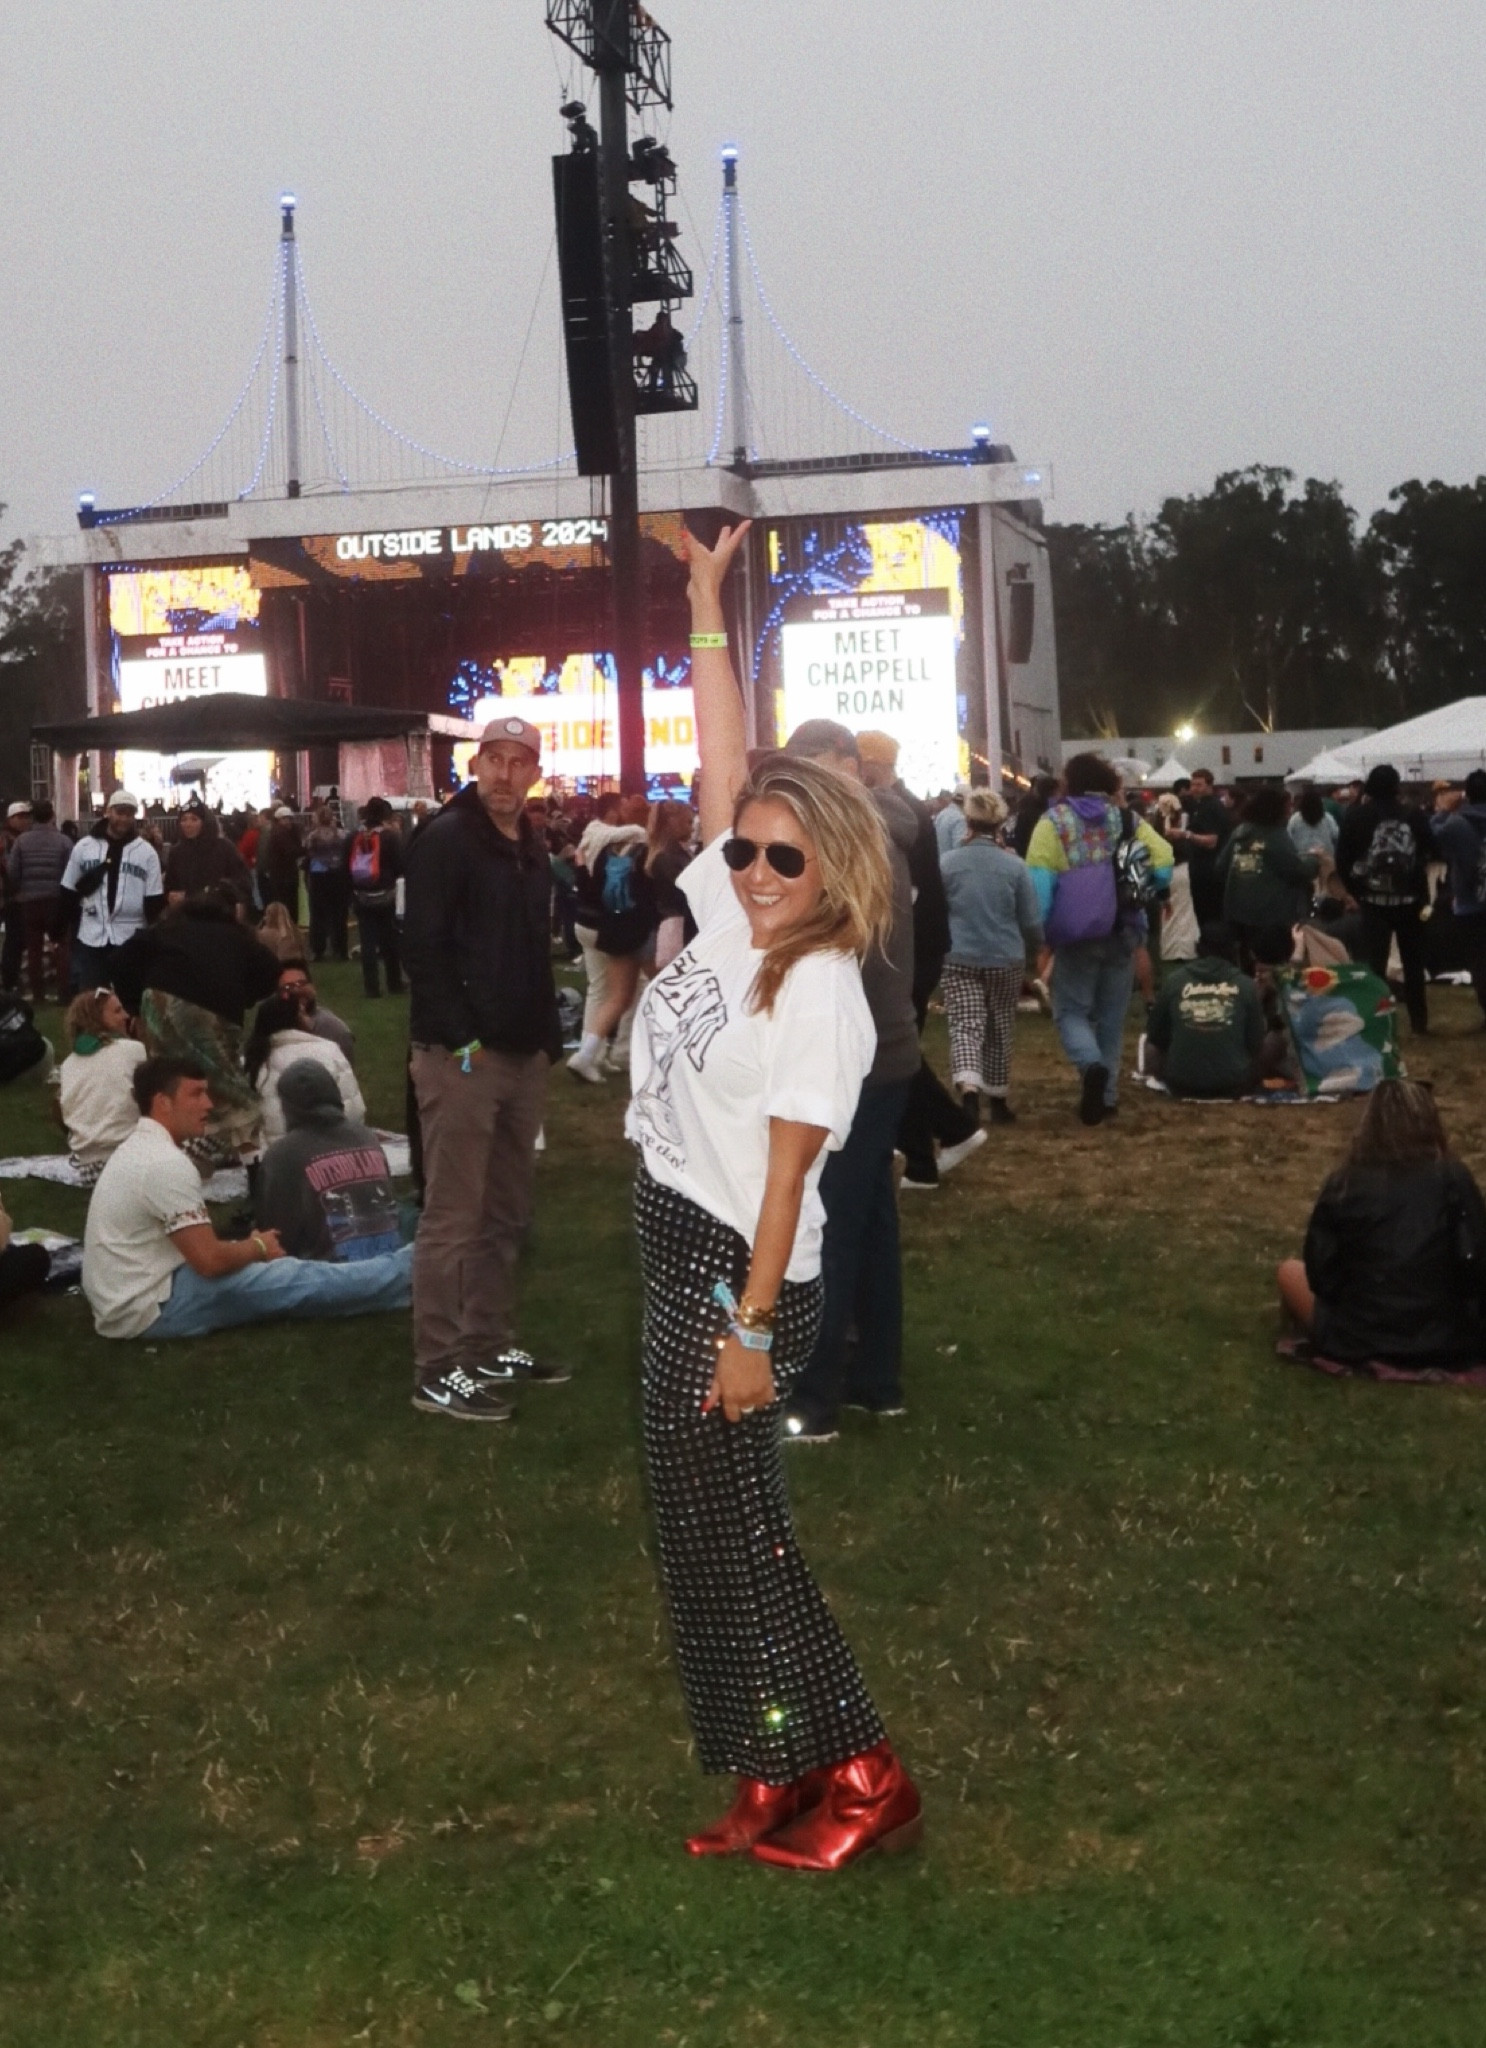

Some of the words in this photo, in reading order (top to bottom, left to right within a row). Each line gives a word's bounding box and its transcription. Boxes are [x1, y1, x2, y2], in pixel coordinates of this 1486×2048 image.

[336, 530, 442, 559] OUTSIDE
[451, 524, 533, 552] LANDS
[541, 519, 608, 546] 2024
[835, 629, 901, 654] MEET
[164, 665, 222, 689] MEET
[808, 657, 931, 686] CHAPPELL
[837, 689, 904, 714] ROAN
[534, 719, 613, 752] SIDE
